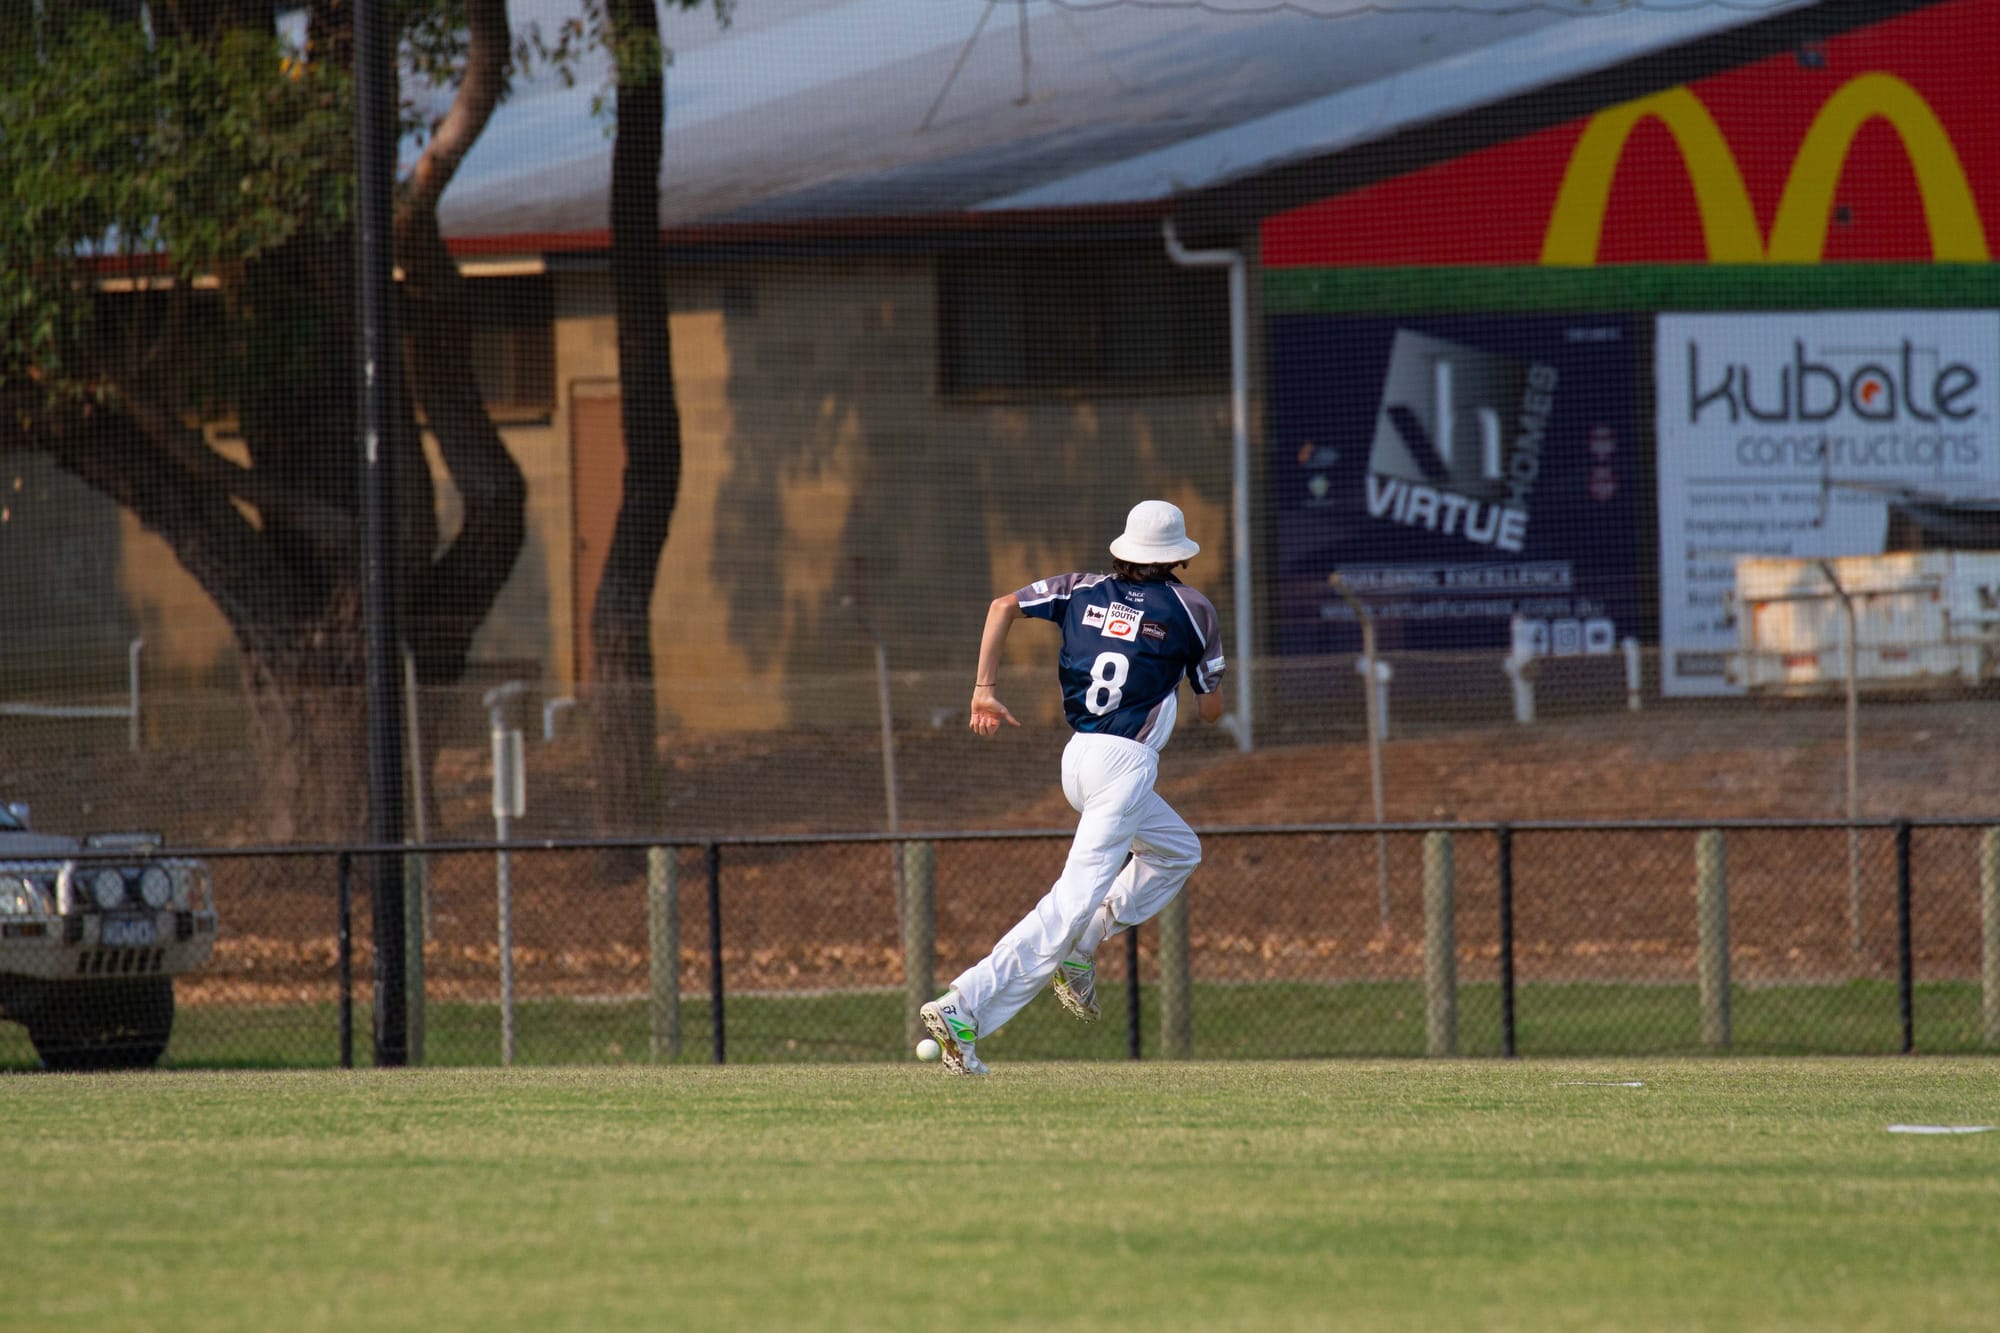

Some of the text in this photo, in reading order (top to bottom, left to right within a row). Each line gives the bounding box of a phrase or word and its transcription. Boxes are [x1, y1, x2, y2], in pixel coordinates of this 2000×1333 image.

[1687, 337, 1980, 424] kubale
[1365, 474, 1530, 552] VIRTUE
[1111, 610, 1137, 622] SOUTH
[1085, 652, 1130, 716] 8
